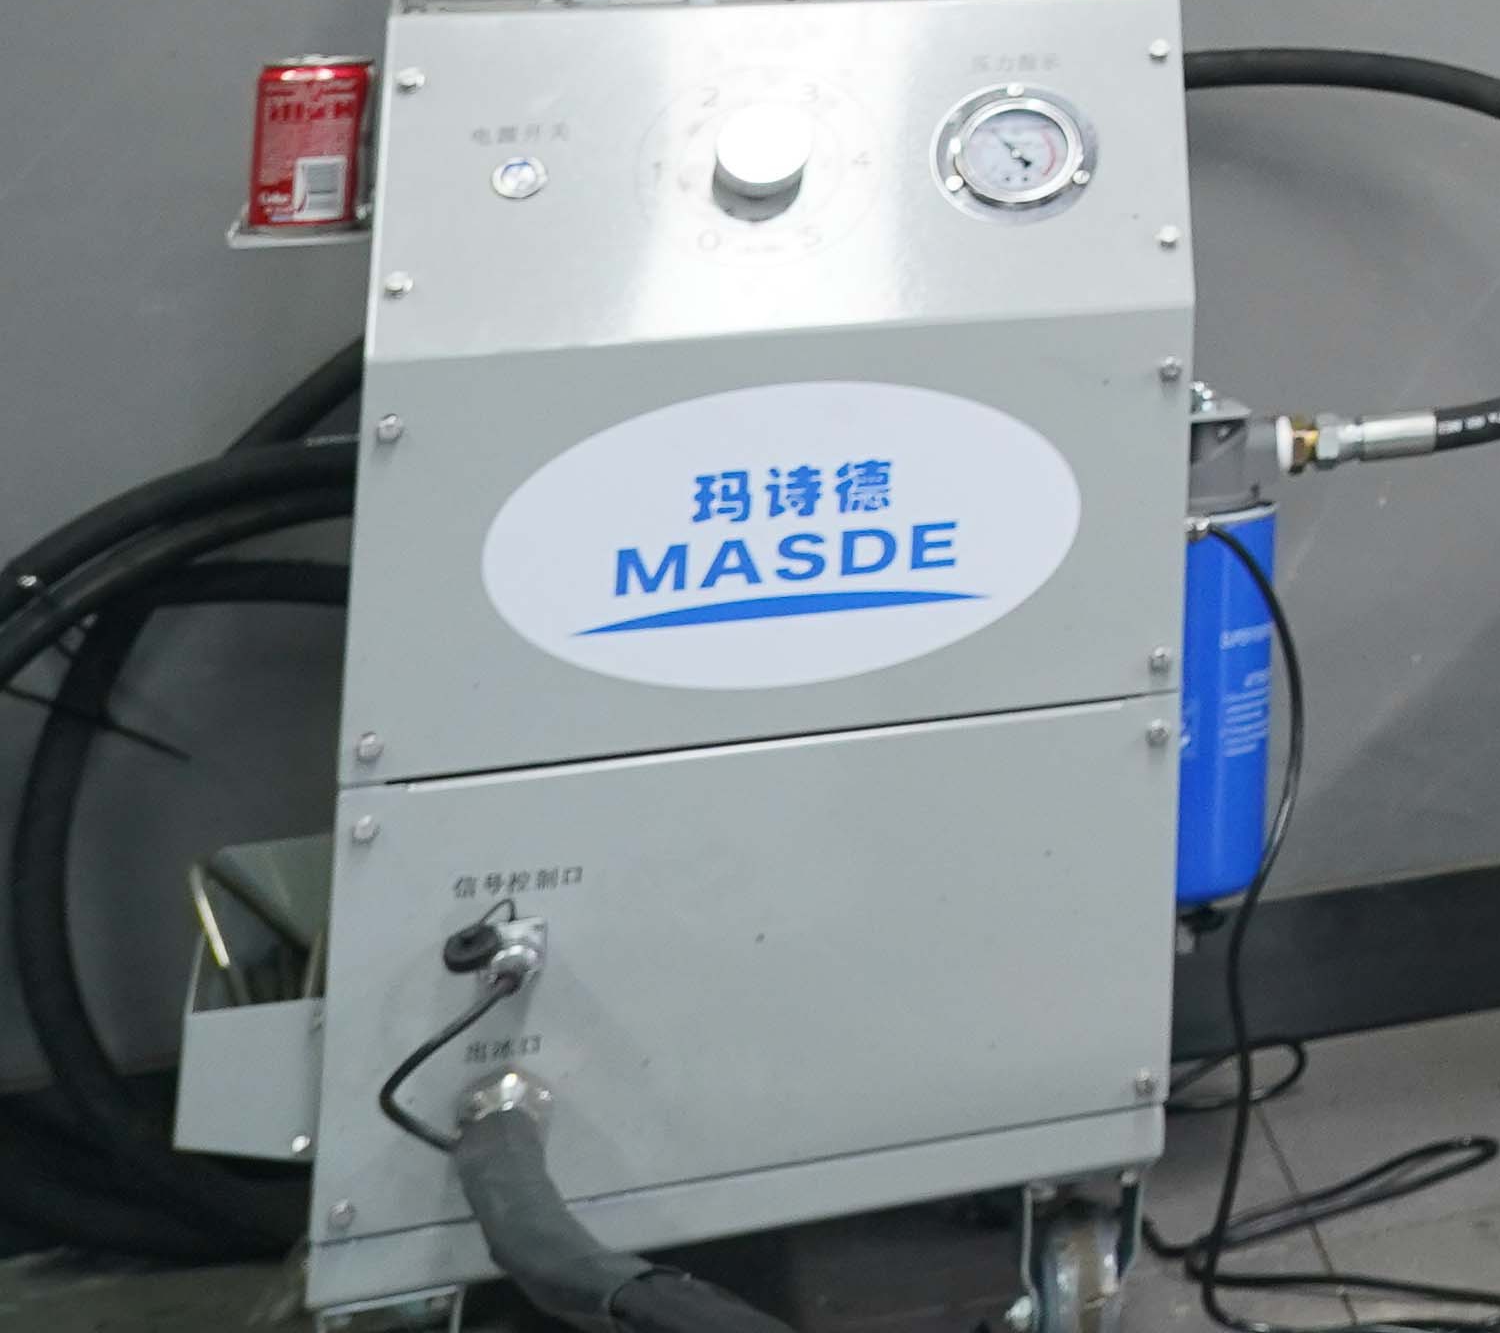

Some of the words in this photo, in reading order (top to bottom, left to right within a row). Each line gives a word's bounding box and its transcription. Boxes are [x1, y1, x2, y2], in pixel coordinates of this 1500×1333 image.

[692, 459, 893, 523] 玛诗德
[614, 521, 958, 596] MASDE
